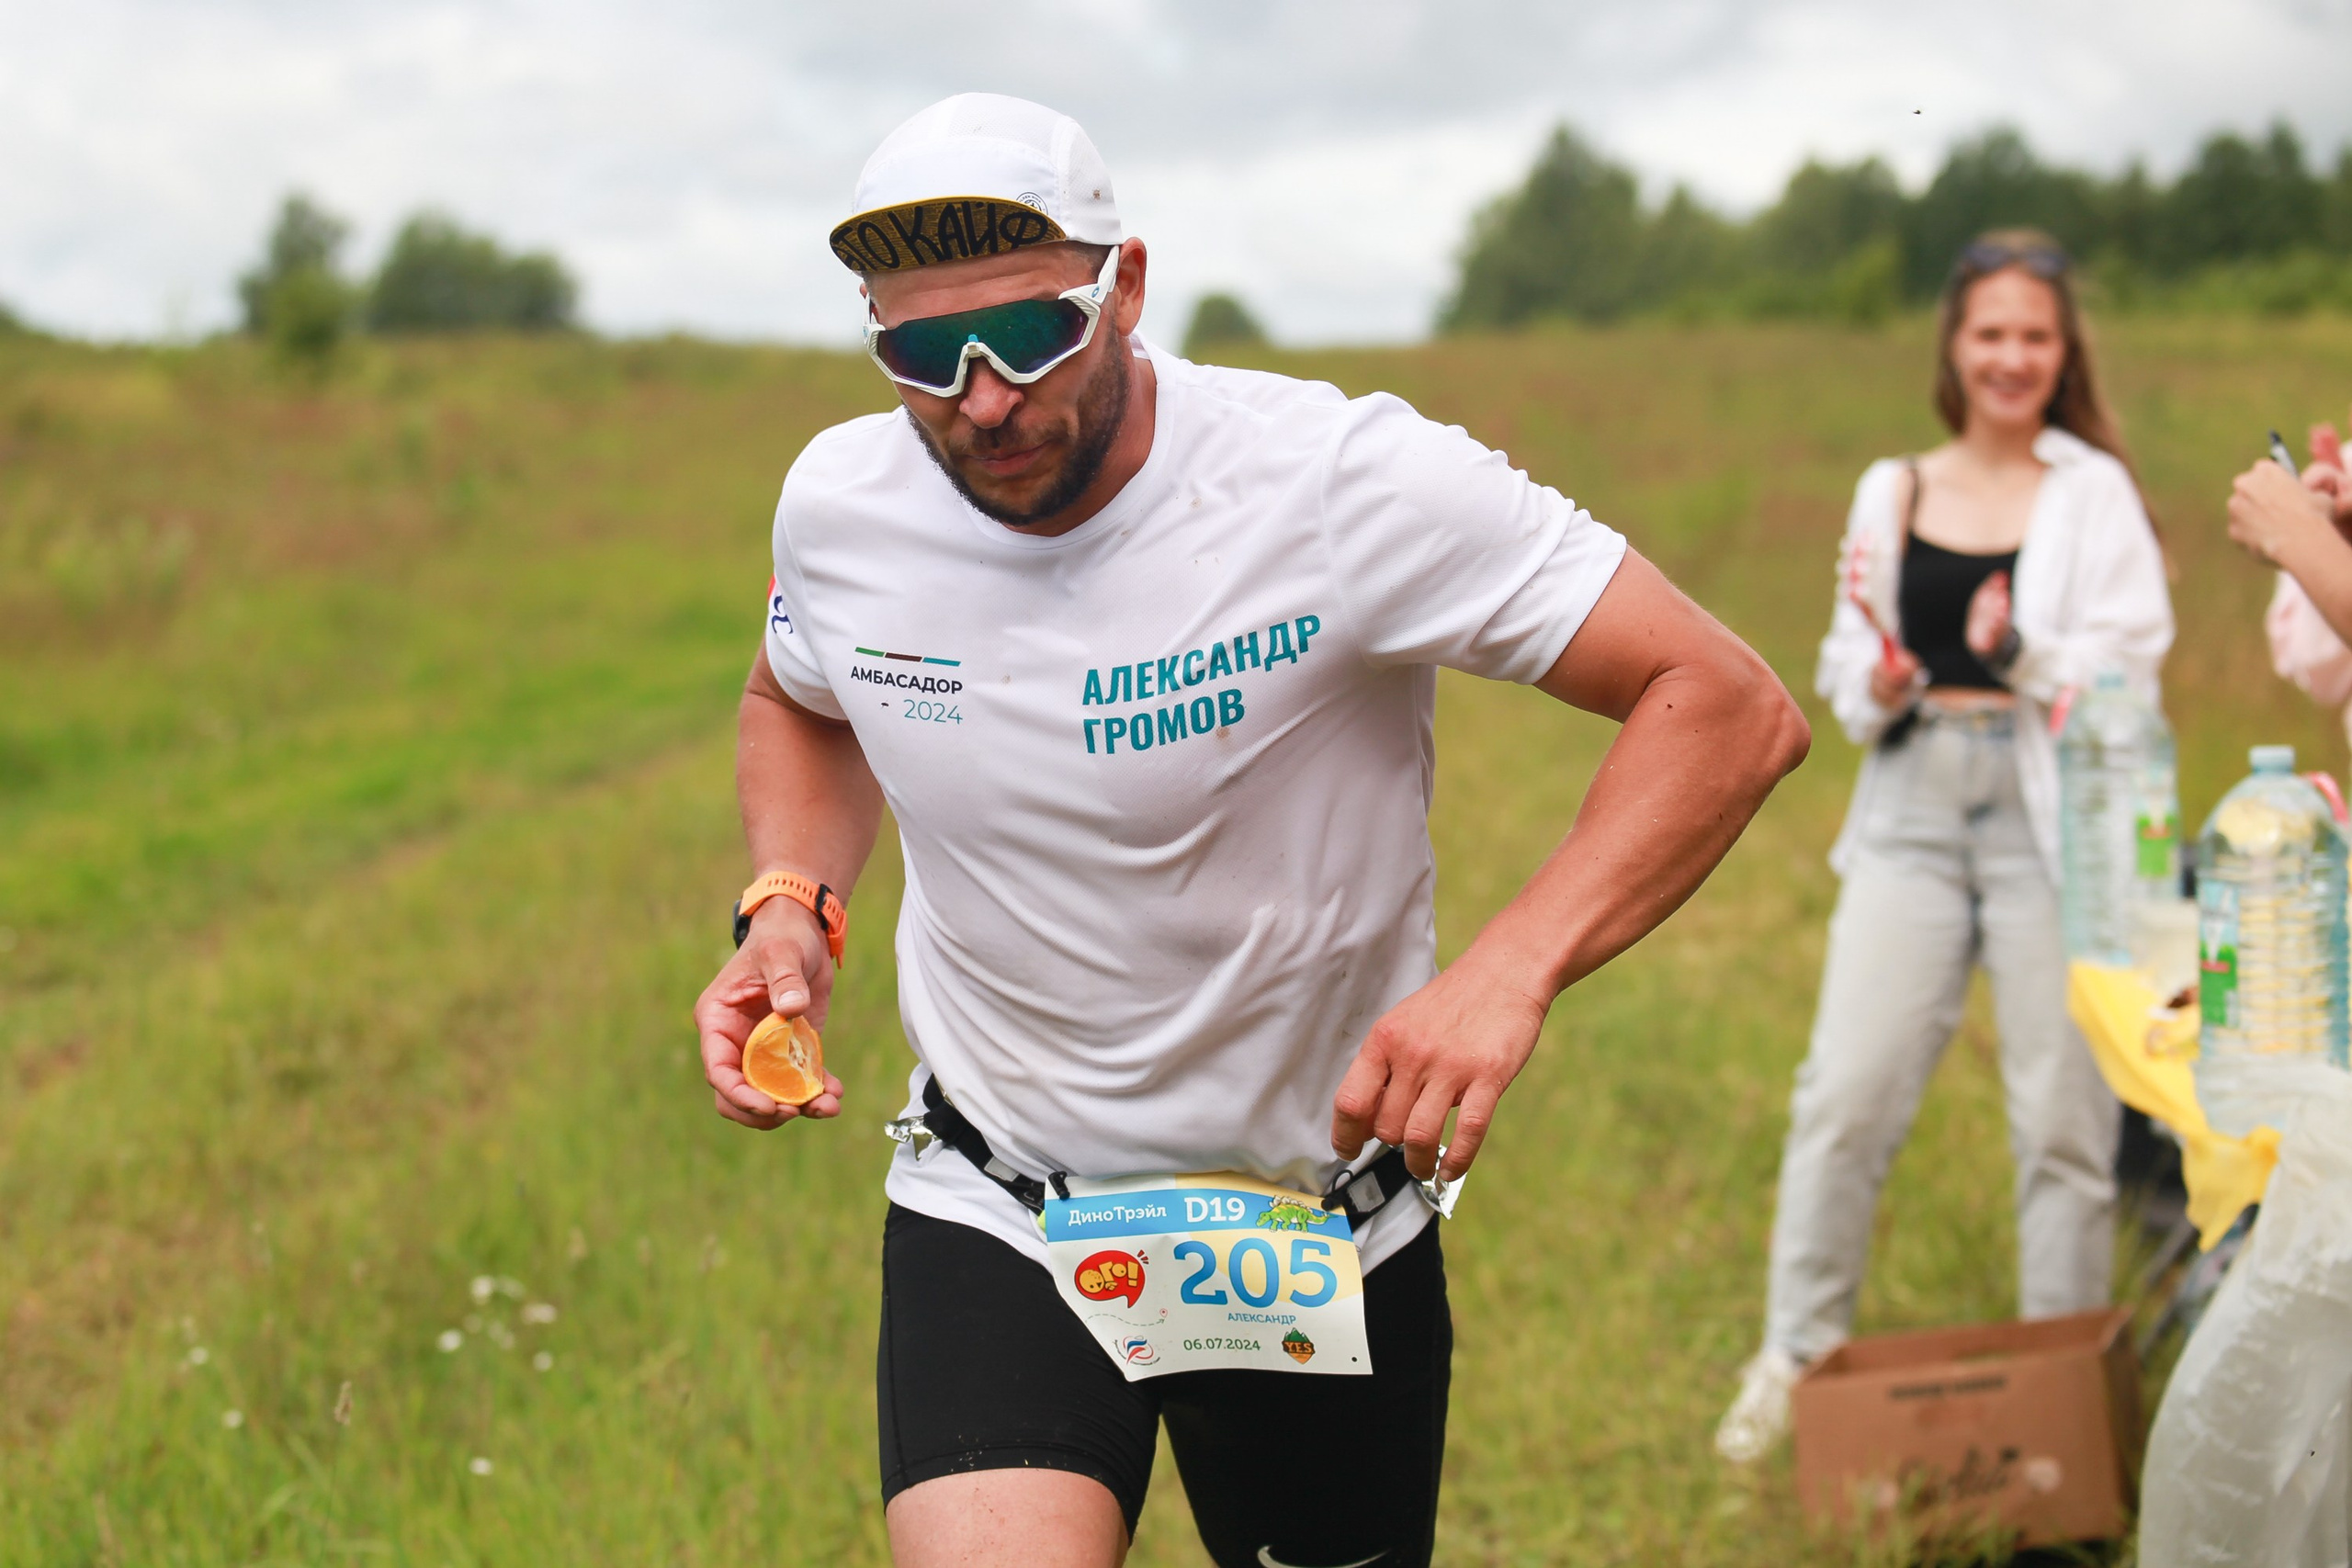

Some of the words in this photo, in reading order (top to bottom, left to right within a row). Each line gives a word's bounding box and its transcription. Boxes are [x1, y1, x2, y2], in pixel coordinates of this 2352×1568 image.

[887, 199, 1048, 265] КАЙФ
[1082, 615, 1320, 705] АЛЕКСАНДР
[850, 666, 963, 694] АМБАСАДОР
[903, 699, 963, 725] 2024
[1083, 689, 1246, 754] ГРОМОВ
[1068, 1203, 1168, 1227] ДиноТрэйл
[1183, 1197, 1246, 1224] D19
[1172, 1237, 1338, 1308] 205
[1227, 1313, 1296, 1325] АЛЕКСАНДР
[1183, 1337, 1261, 1351] 06.07.2024
[1283, 1341, 1313, 1353] YES
